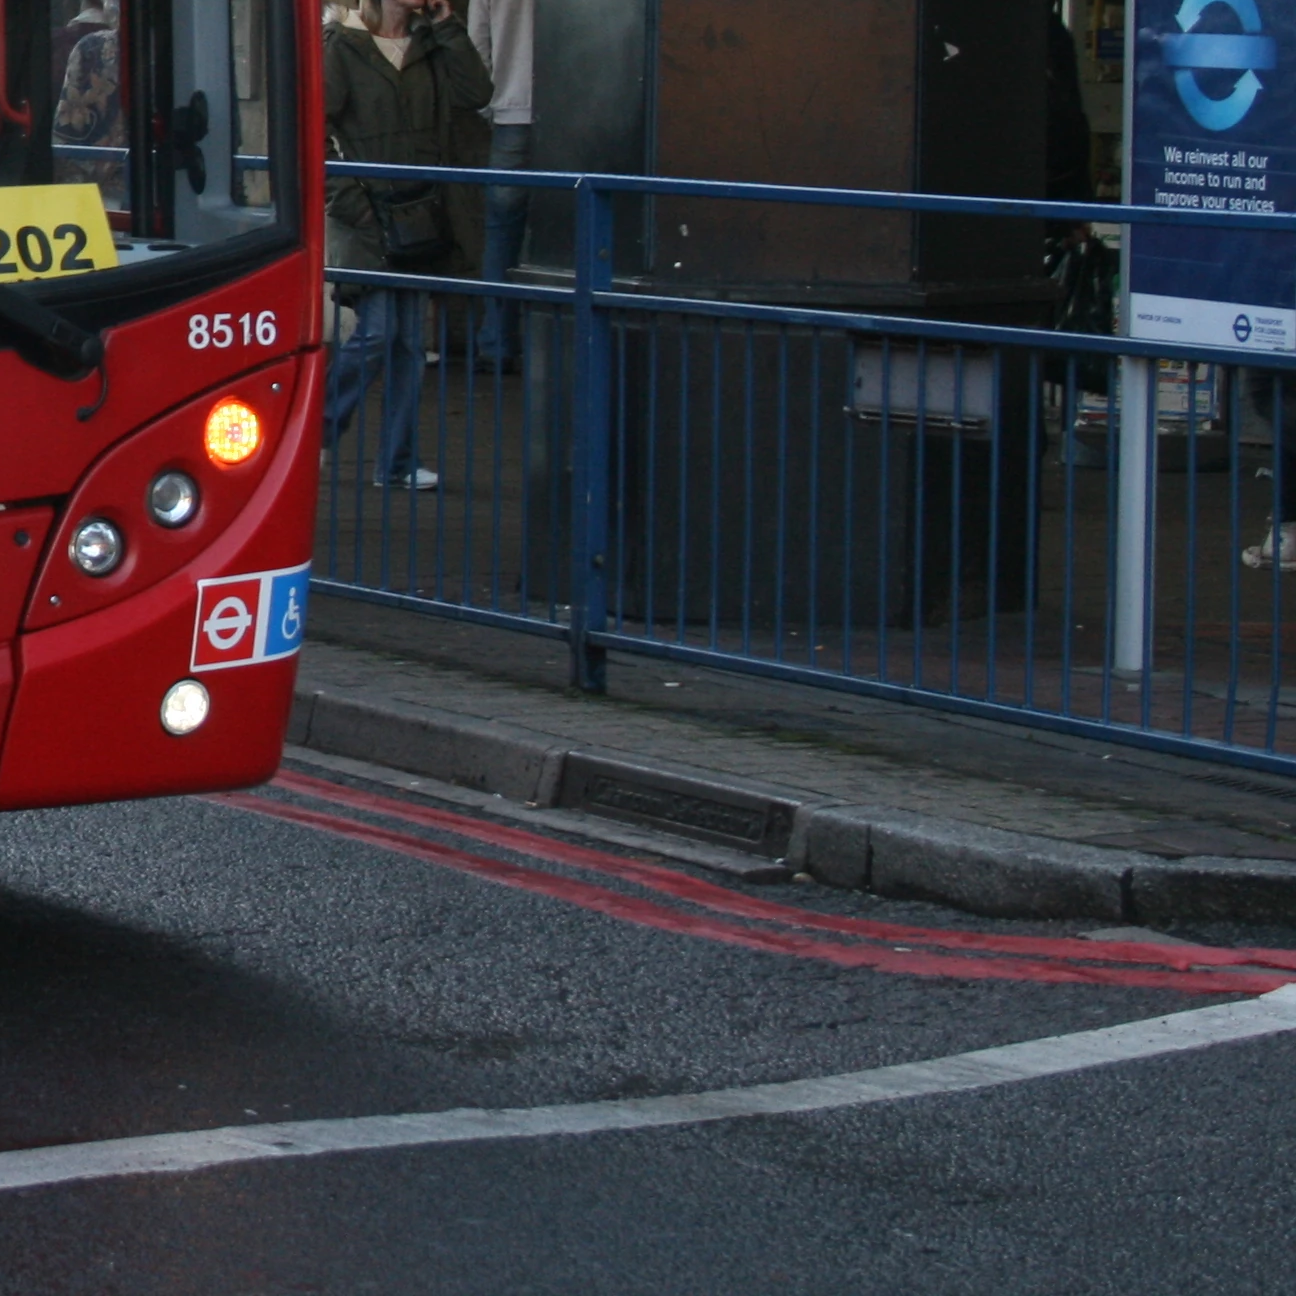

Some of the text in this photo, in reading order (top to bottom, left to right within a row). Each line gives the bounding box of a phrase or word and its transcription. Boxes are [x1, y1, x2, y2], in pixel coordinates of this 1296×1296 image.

[1164, 146, 1268, 169] We reinvest all our
[1164, 168, 1266, 191] income to run and
[1155, 188, 1275, 213] improve your services
[188, 310, 276, 350] 8516
